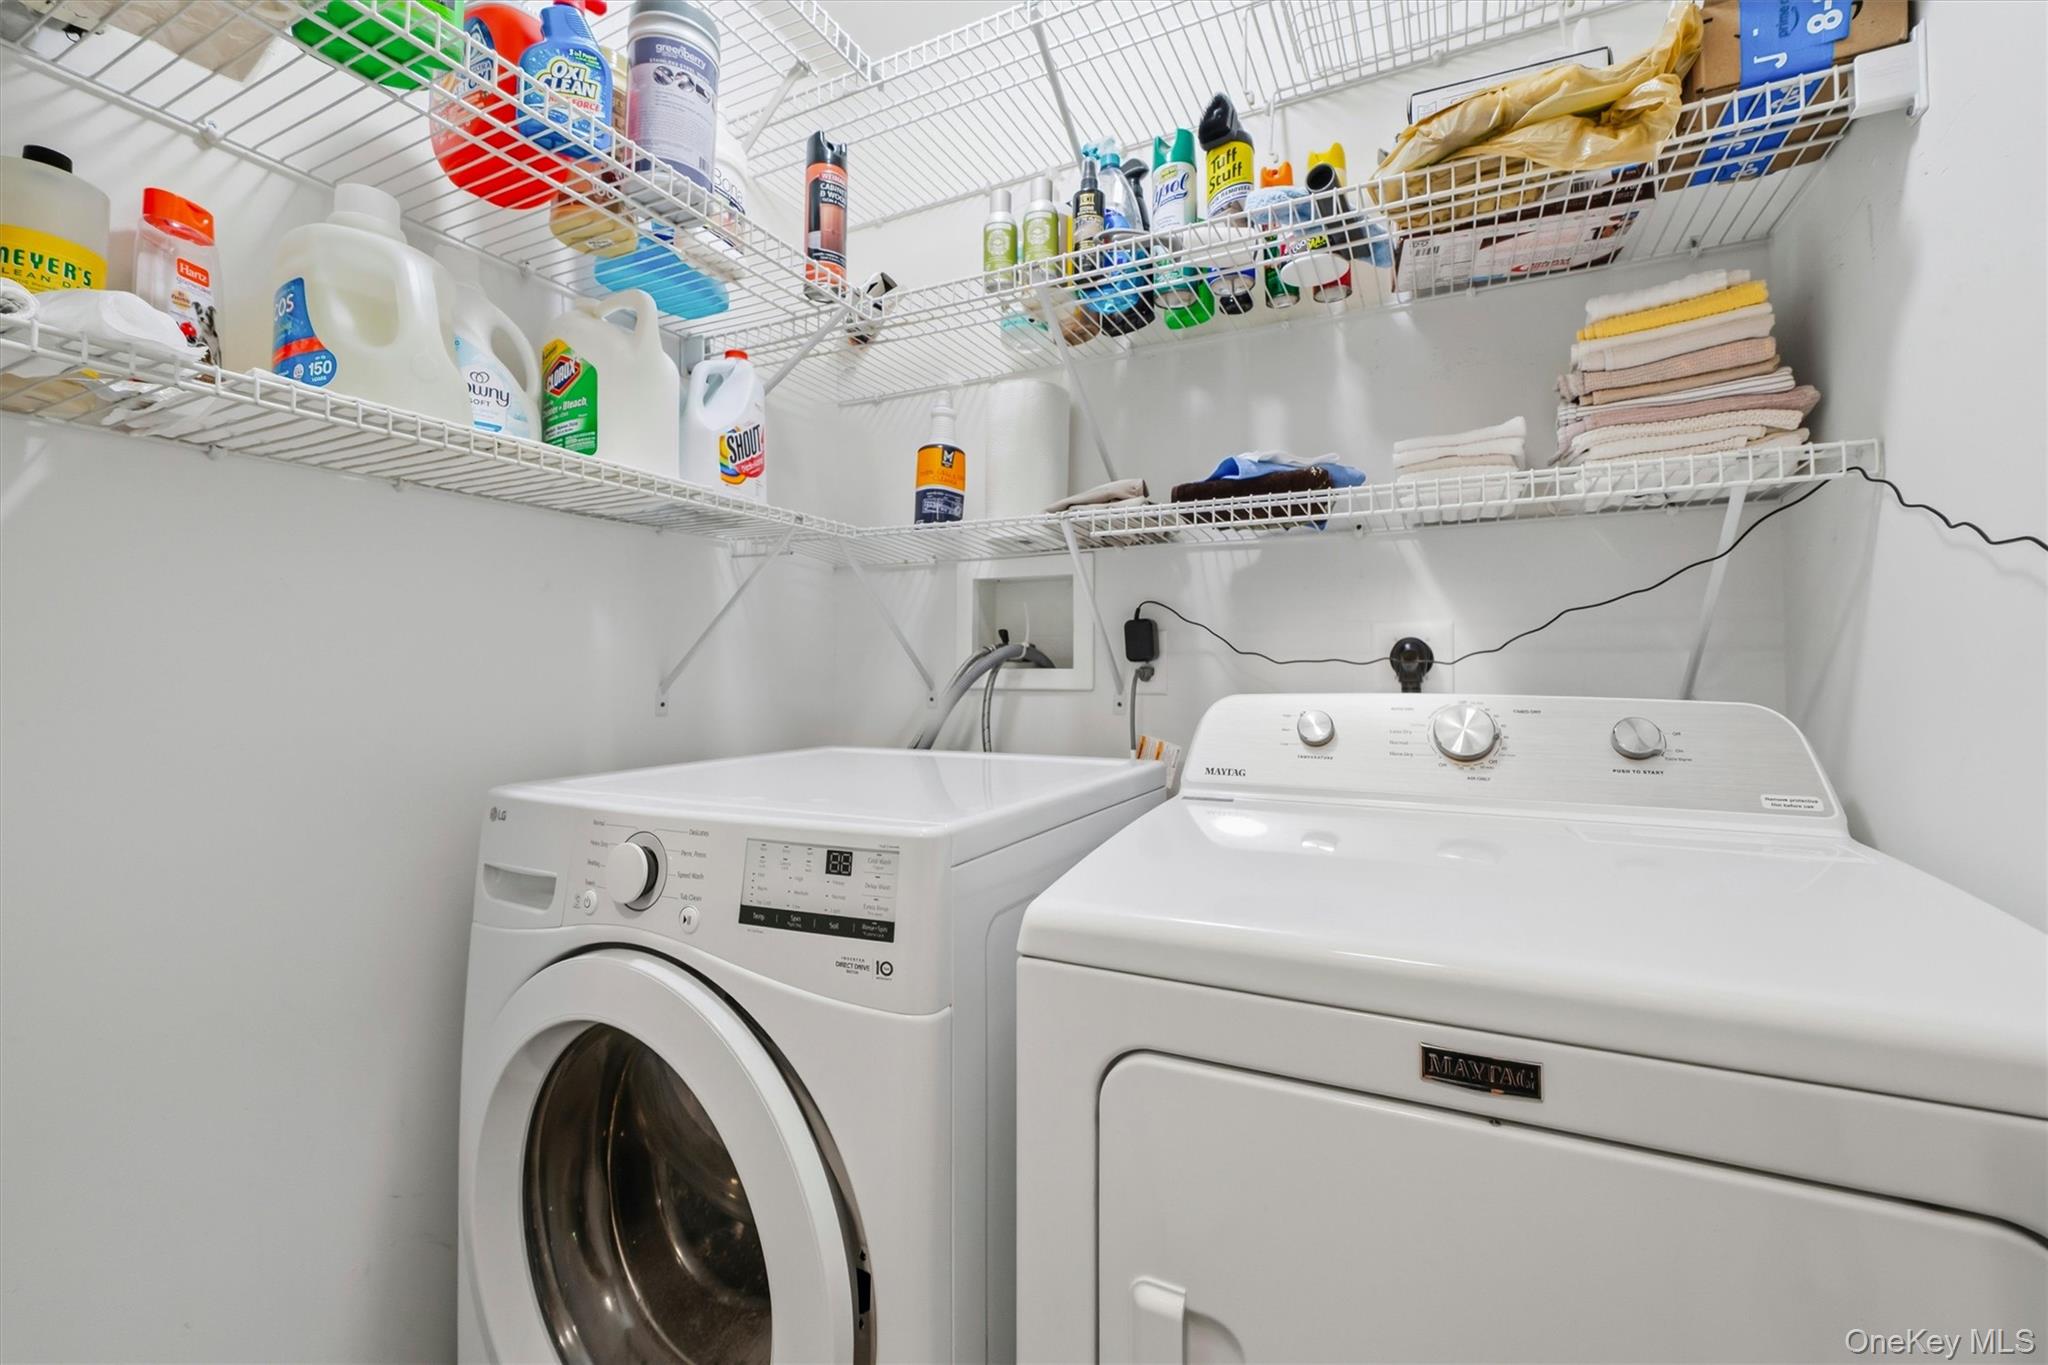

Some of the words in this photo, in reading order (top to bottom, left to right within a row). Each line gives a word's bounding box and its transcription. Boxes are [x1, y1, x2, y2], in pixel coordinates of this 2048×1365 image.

[656, 44, 706, 70] greenberry
[551, 60, 586, 80] OXI
[538, 74, 597, 98] CLEAN
[1210, 146, 1237, 174] Tuff
[1, 267, 51, 283] LEAN
[179, 261, 209, 282] Hartz
[308, 360, 333, 377] 150
[467, 382, 510, 408] wny
[562, 397, 588, 411] Bleach
[726, 423, 762, 464] SHOUT
[1204, 766, 1247, 777] MAYTAG
[1428, 1052, 1536, 1091] MAYTAG
